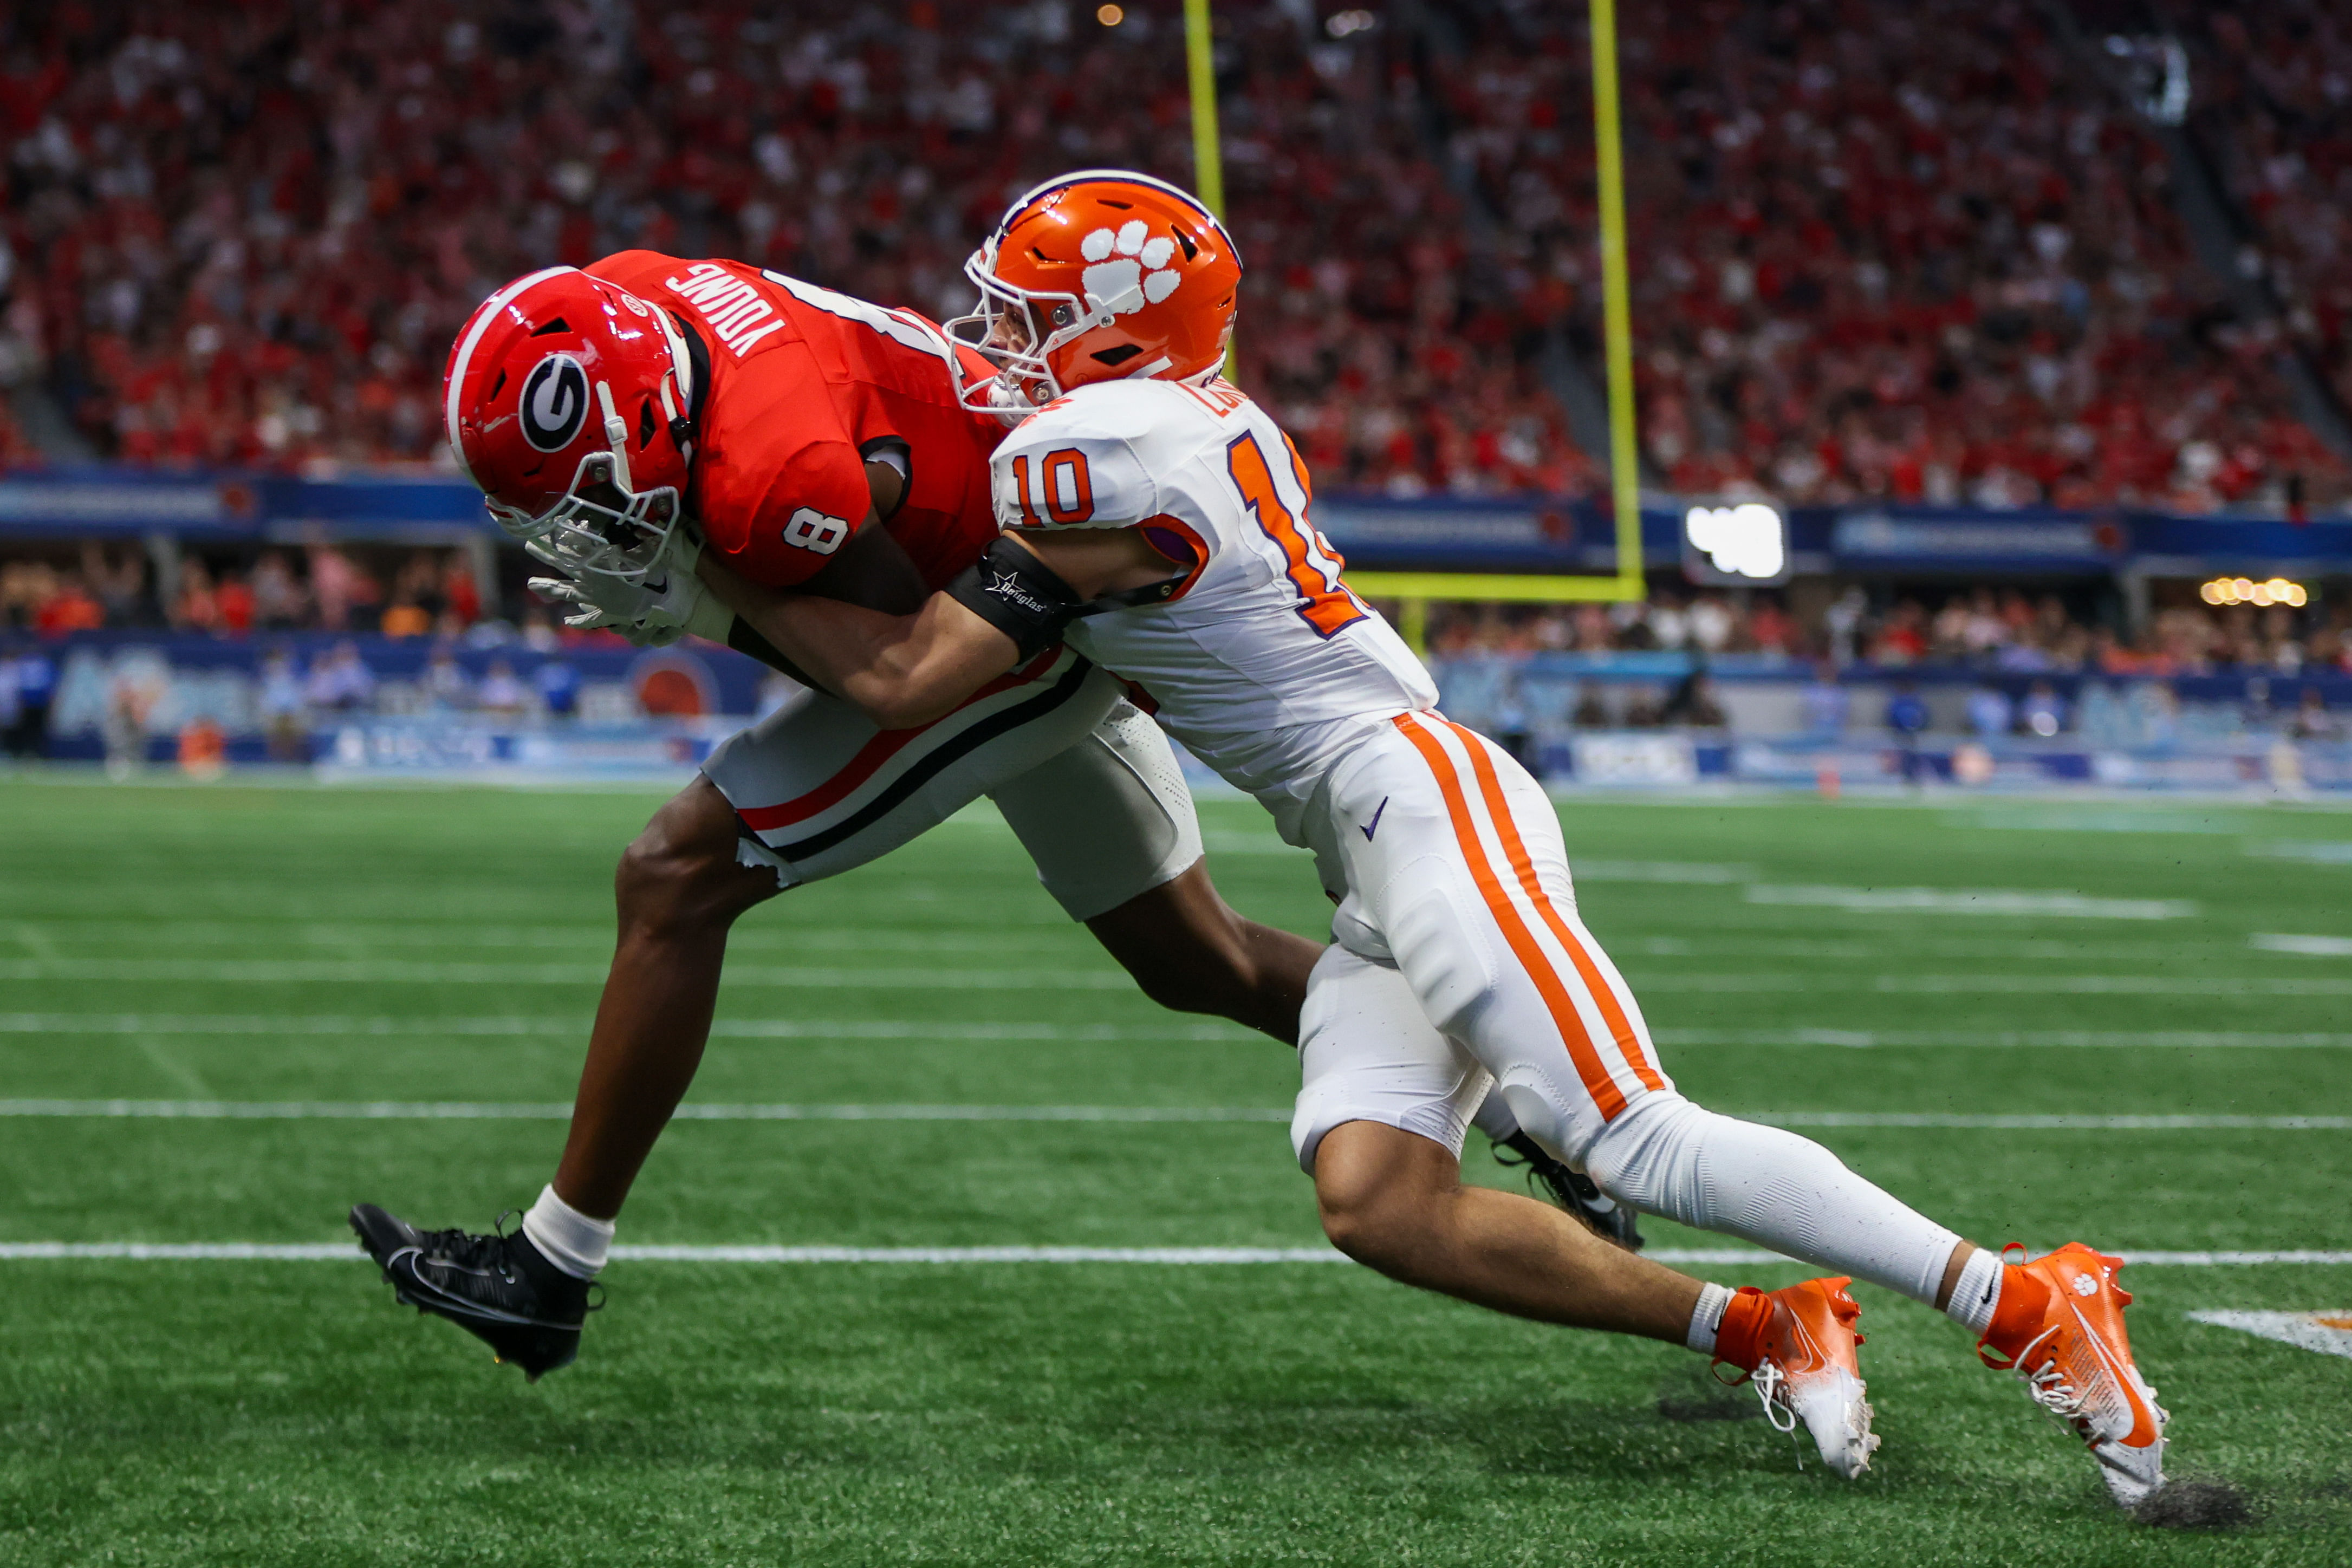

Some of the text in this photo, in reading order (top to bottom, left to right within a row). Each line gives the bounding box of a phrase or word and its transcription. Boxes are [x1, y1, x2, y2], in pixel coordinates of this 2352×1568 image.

[665, 264, 785, 358] YOUNG
[522, 355, 587, 451] G
[782, 505, 849, 556] 8
[1012, 447, 1095, 528] 10
